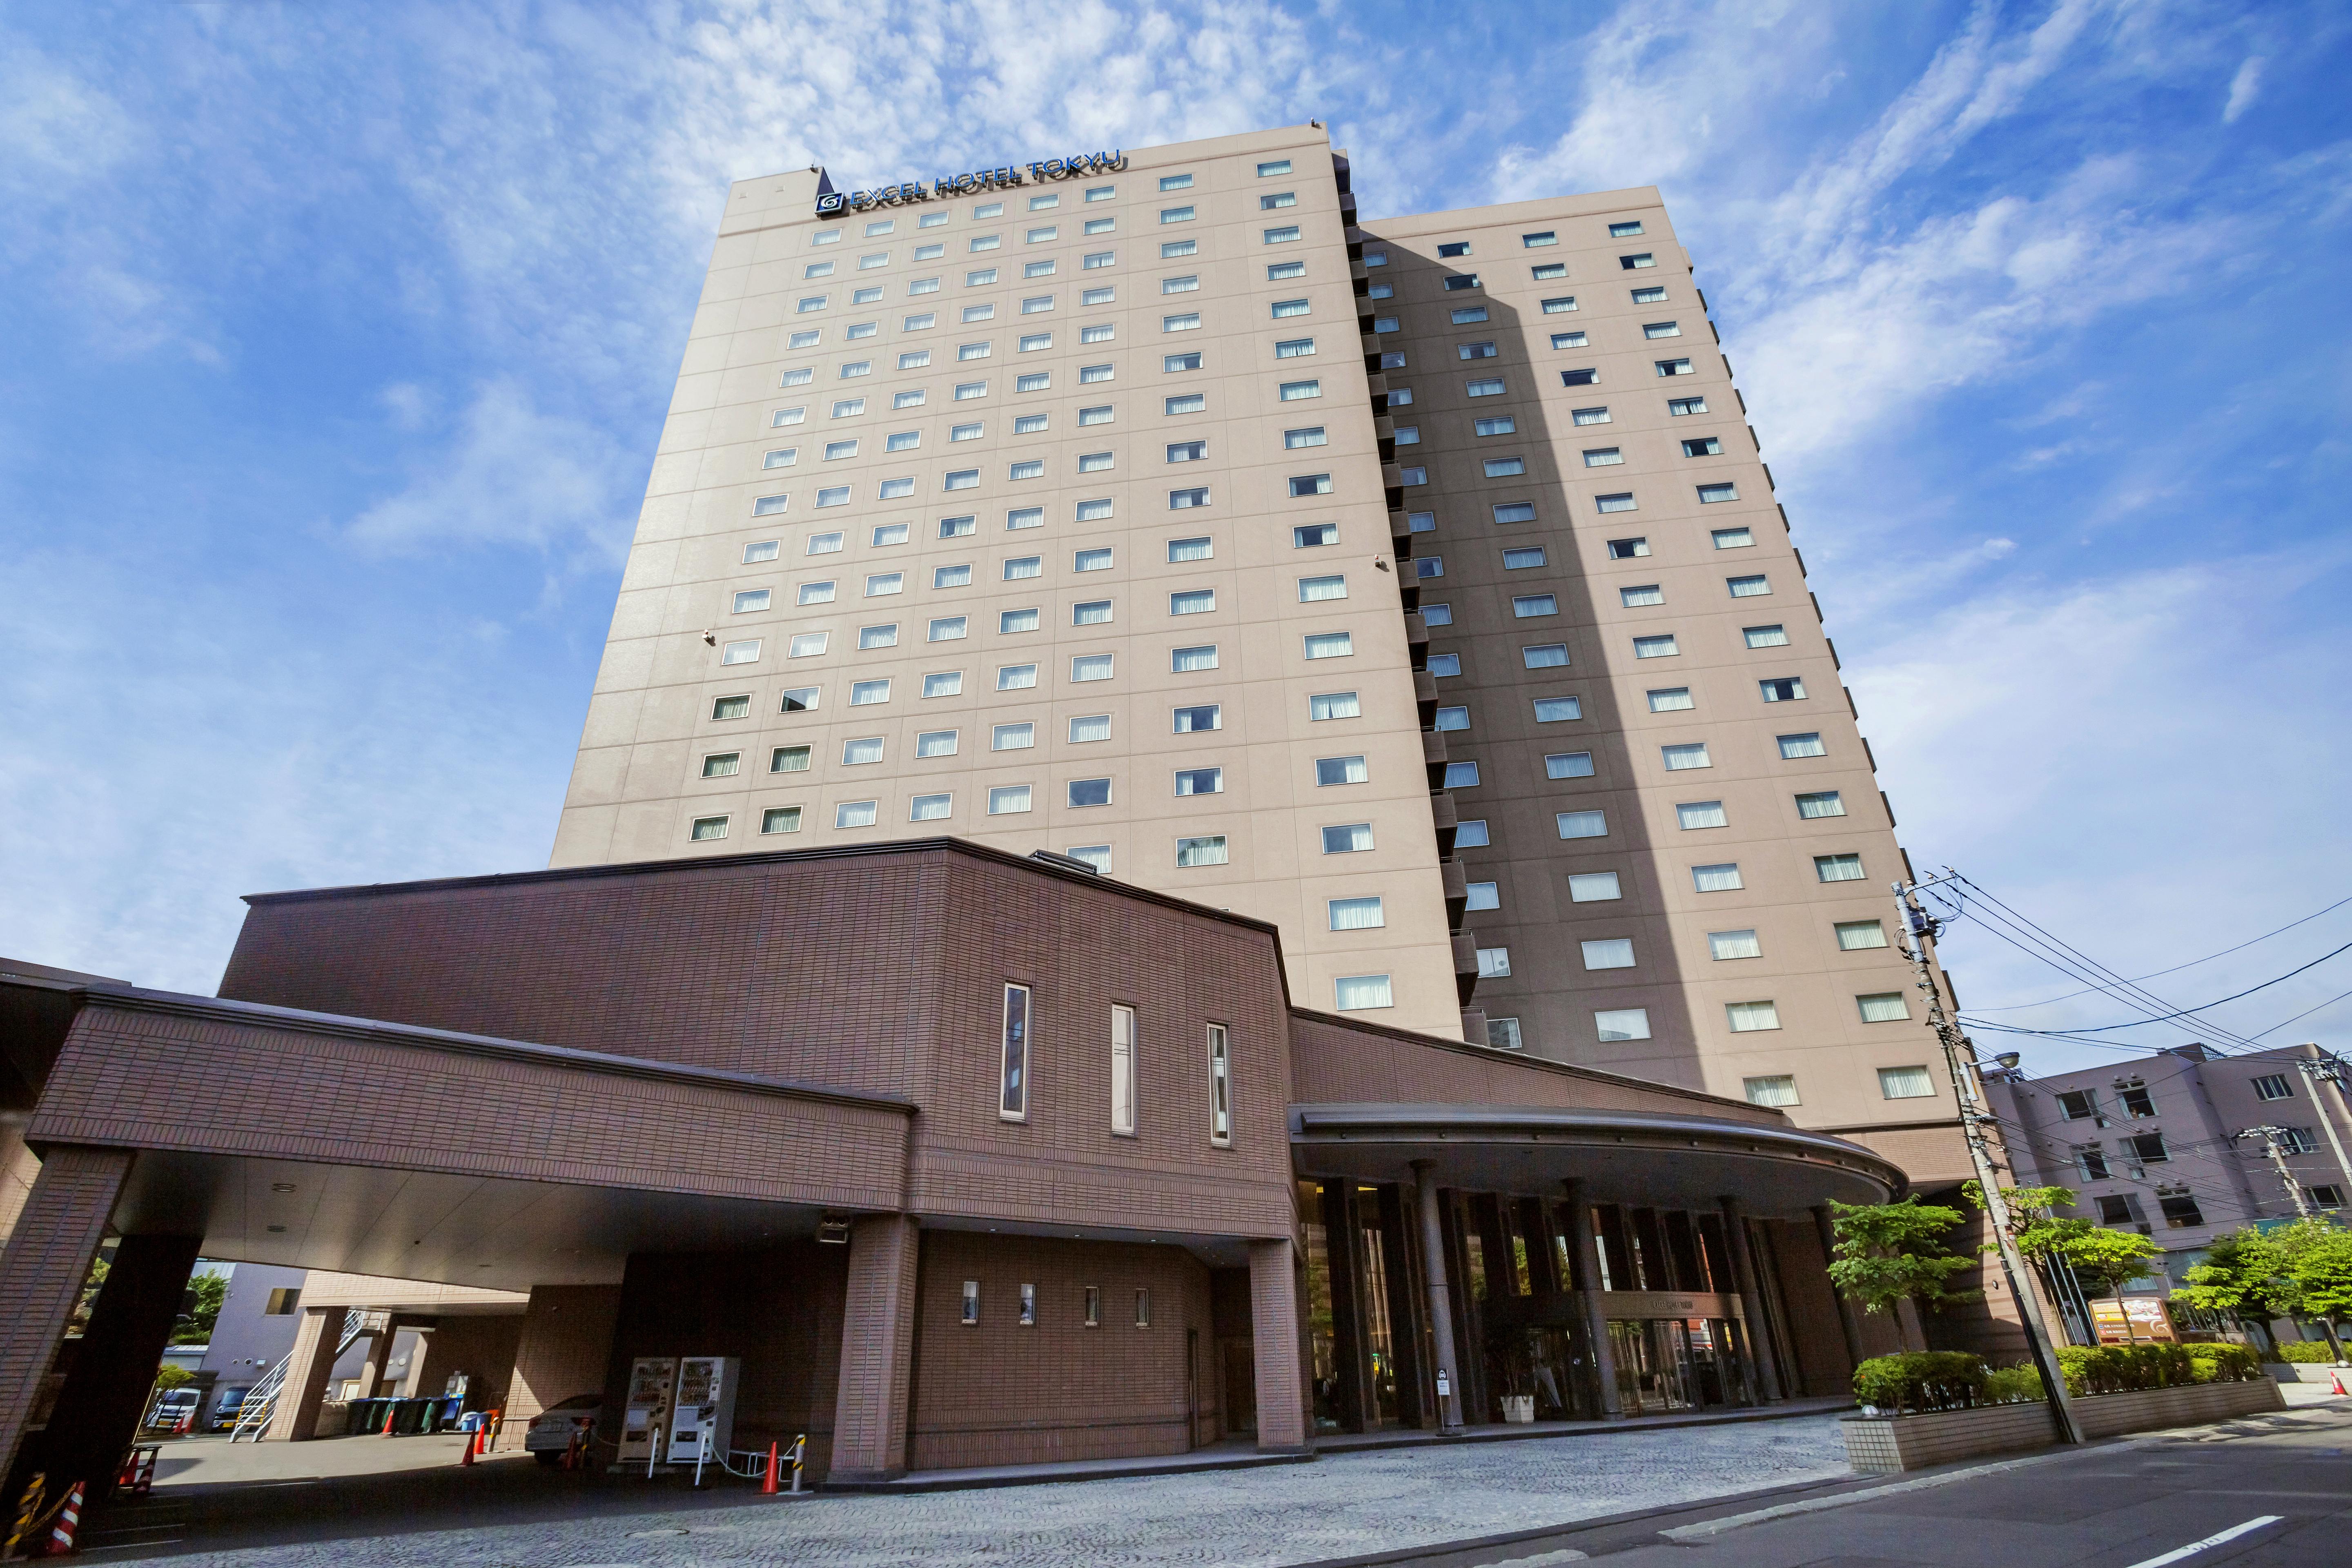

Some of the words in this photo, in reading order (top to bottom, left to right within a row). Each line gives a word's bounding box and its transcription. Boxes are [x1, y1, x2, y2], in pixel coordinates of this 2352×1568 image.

[849, 181, 928, 205] EXCEL
[934, 166, 1022, 192] HOTEL
[1026, 149, 1119, 176] TOKYU
